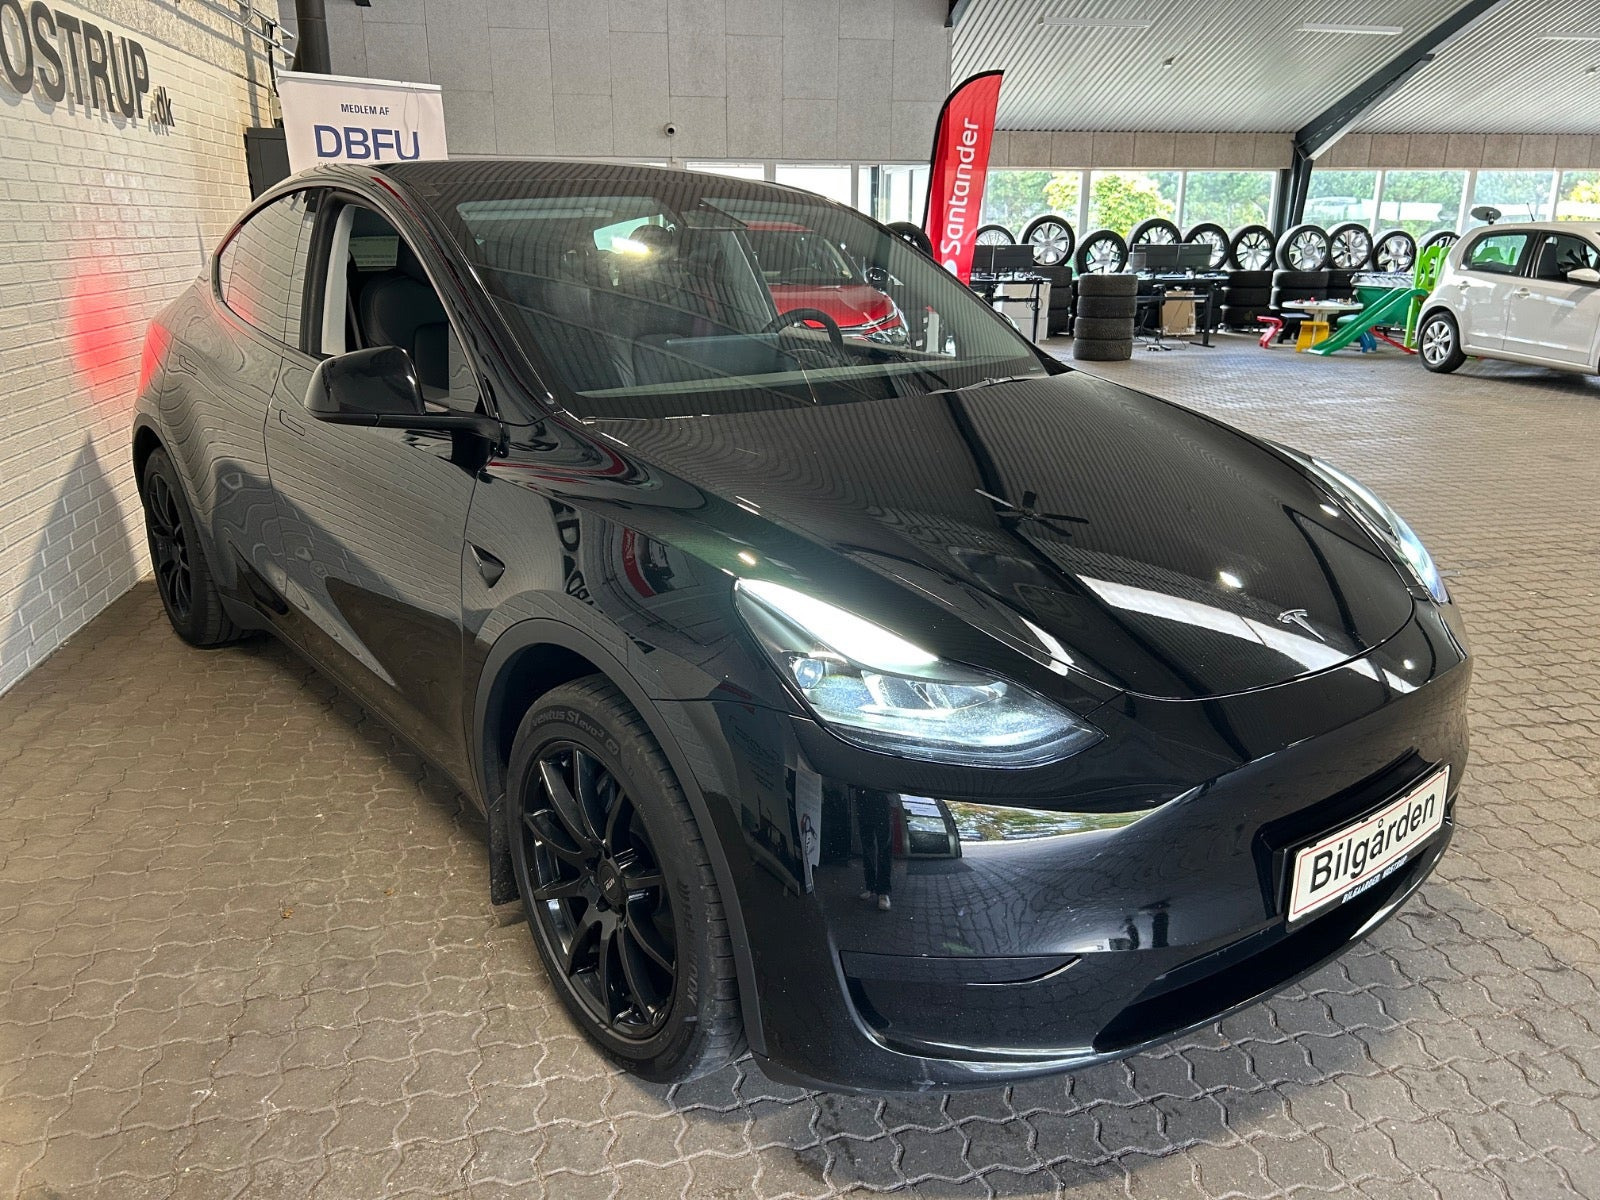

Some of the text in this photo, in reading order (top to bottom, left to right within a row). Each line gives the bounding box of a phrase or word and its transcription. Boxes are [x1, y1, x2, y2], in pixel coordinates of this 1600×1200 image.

[314, 125, 420, 160] DBFU
[341, 103, 391, 116] MEDLEM AF
[940, 118, 980, 255] Santander
[1310, 793, 1436, 893] Bilgården
